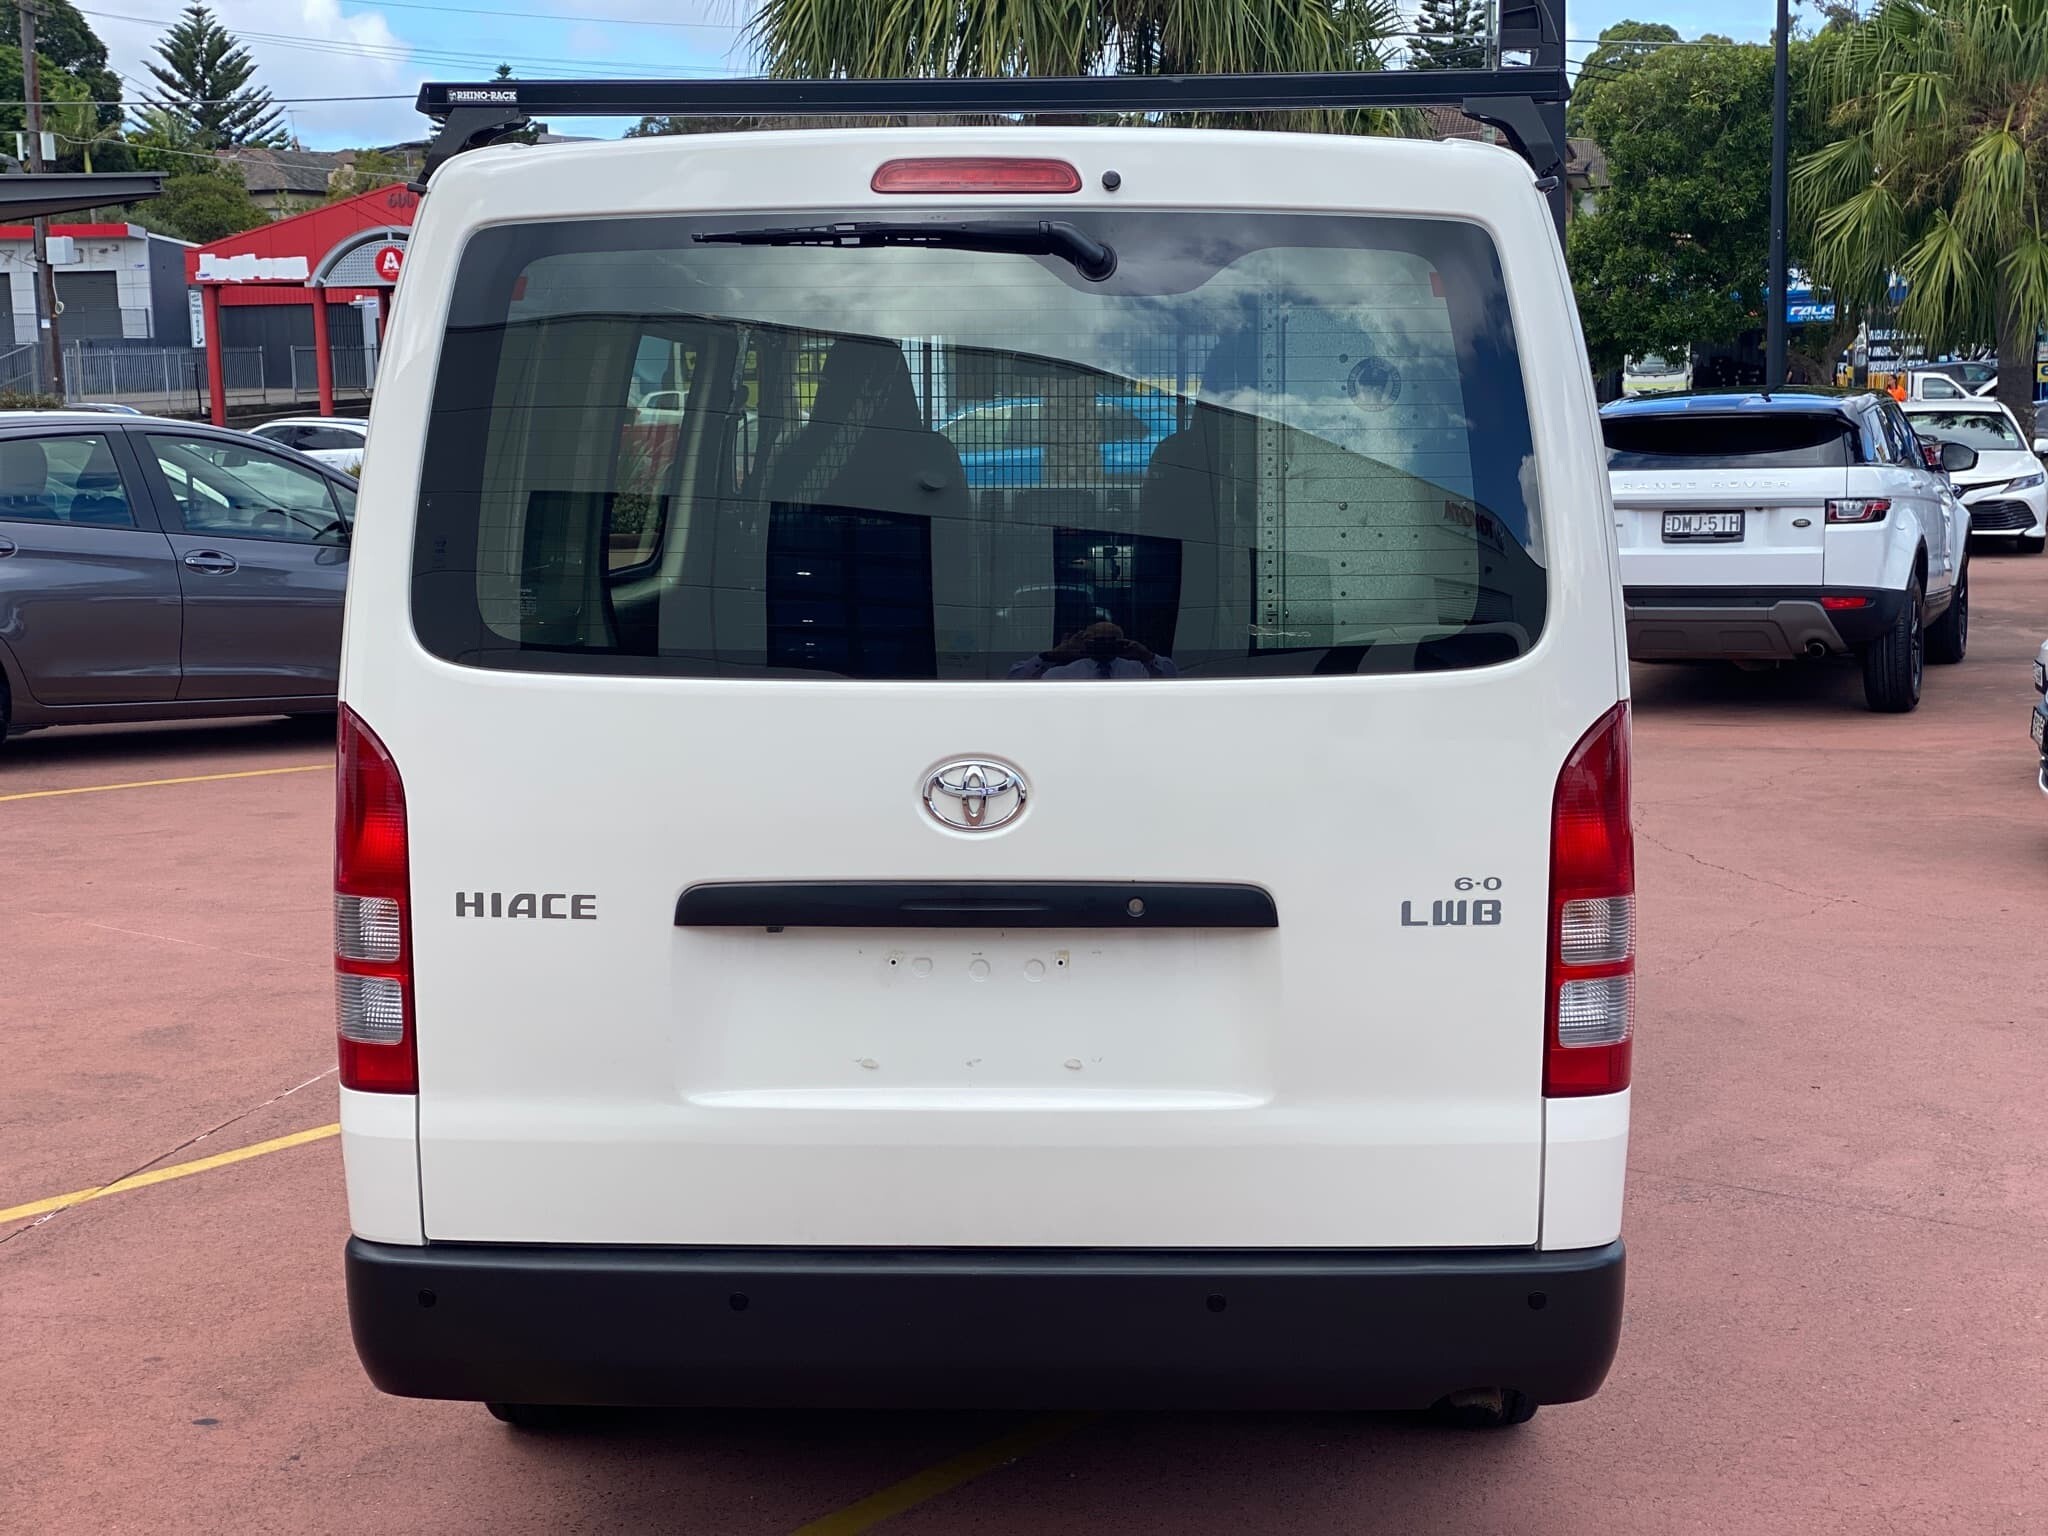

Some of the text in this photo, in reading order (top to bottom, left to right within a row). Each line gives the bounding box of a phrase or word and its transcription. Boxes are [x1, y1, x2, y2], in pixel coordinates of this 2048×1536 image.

[456, 90, 518, 101] RHINO-RACK
[455, 891, 597, 920] HIACE
[1401, 899, 1502, 927] LWB
